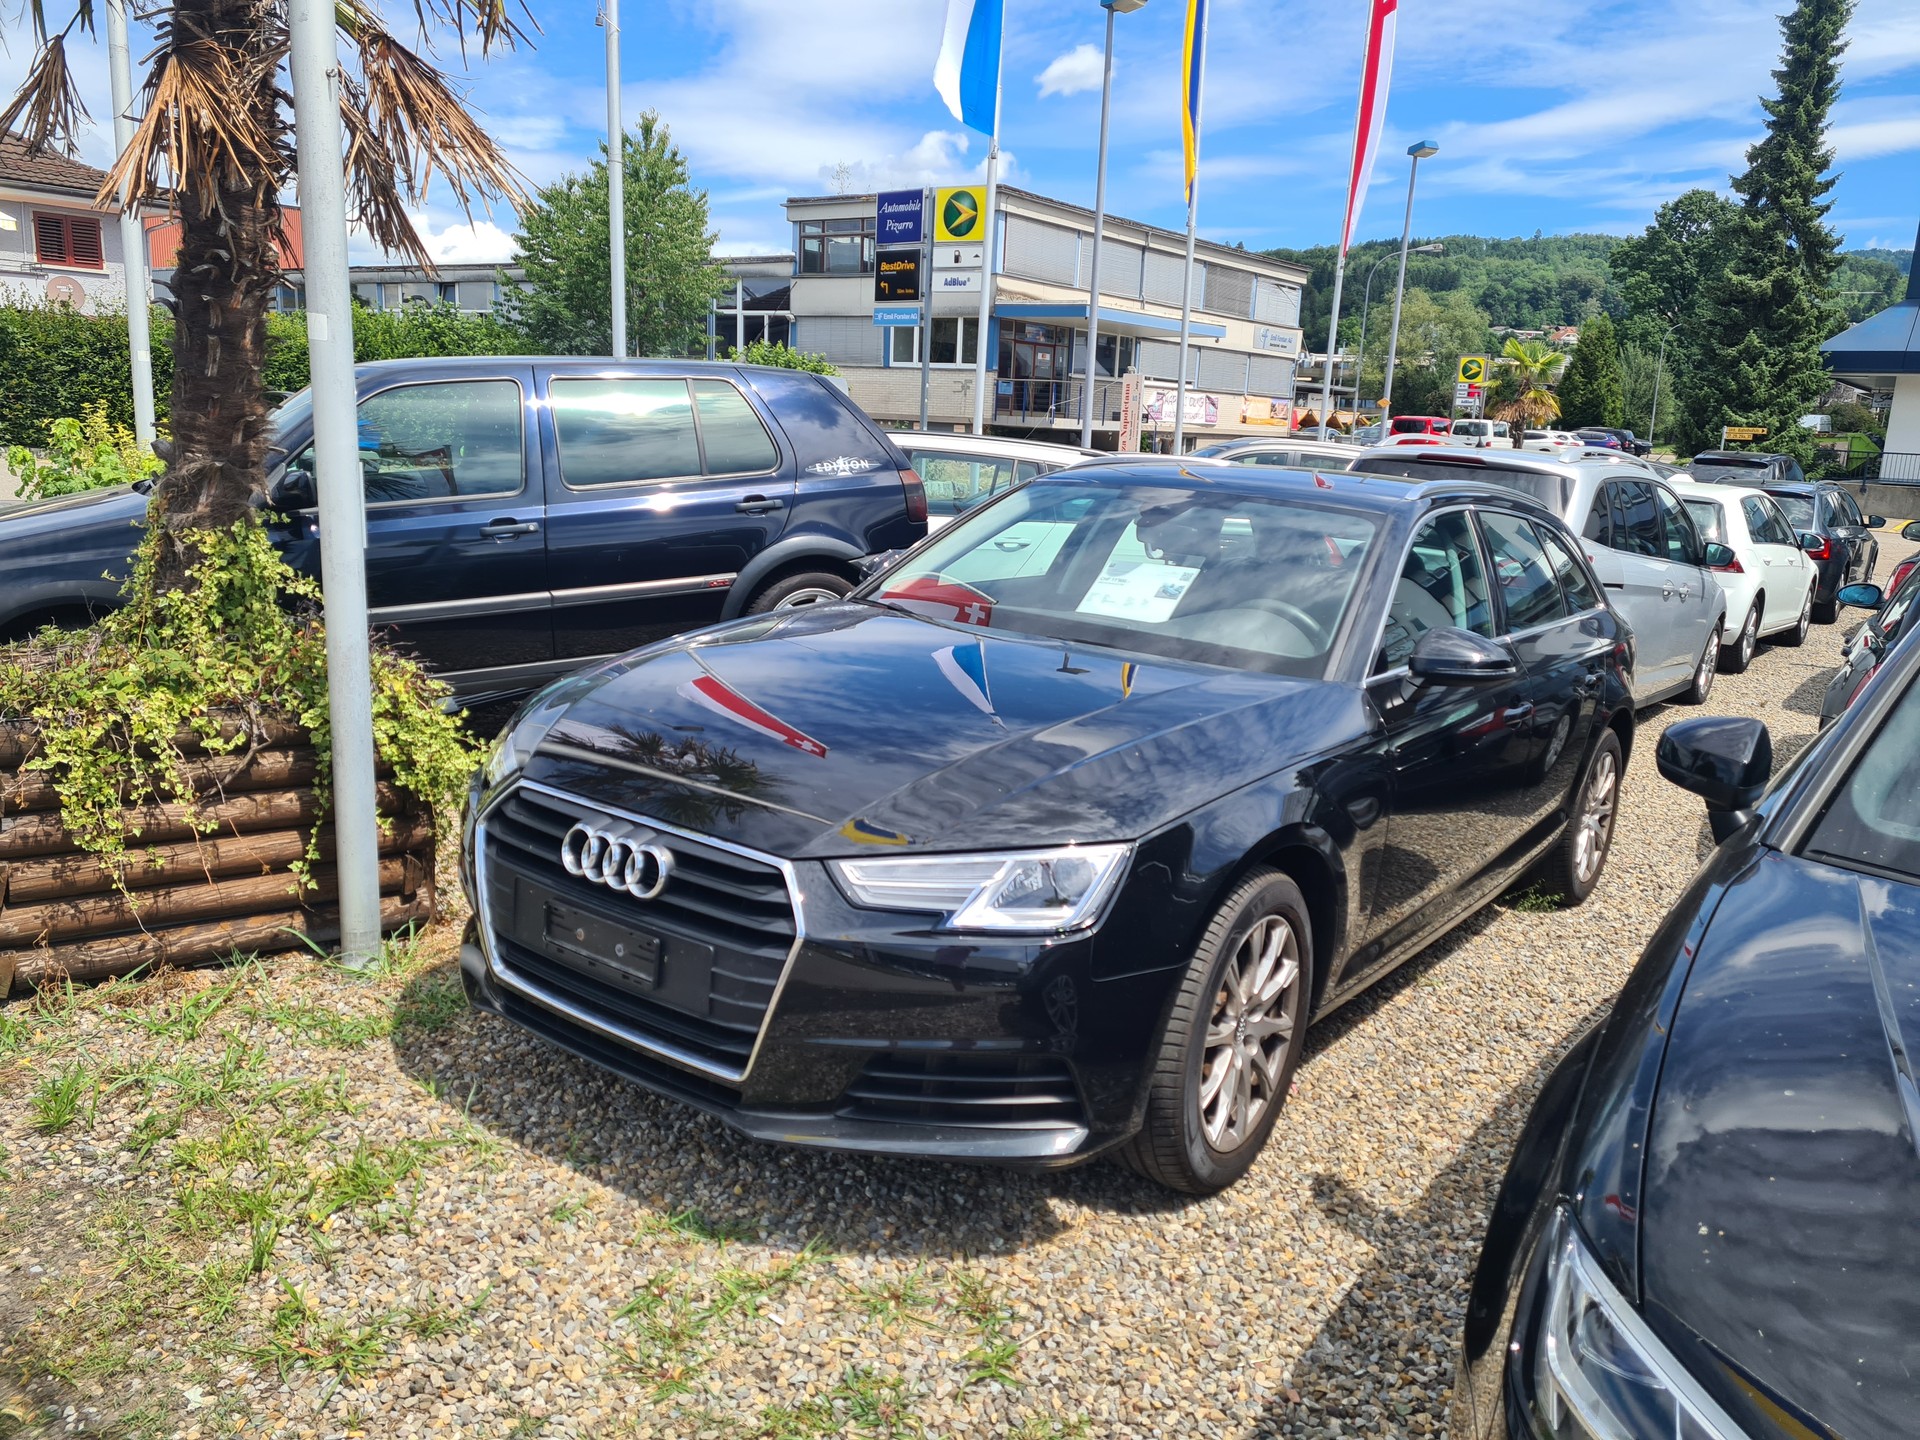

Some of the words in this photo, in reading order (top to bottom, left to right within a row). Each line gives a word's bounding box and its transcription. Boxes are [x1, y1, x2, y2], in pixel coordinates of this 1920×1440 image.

[879, 200, 921, 214] Automobile
[885, 219, 914, 233] Pizarro
[880, 261, 915, 271] BestDrive
[1120, 383, 1131, 437] Napoletana
